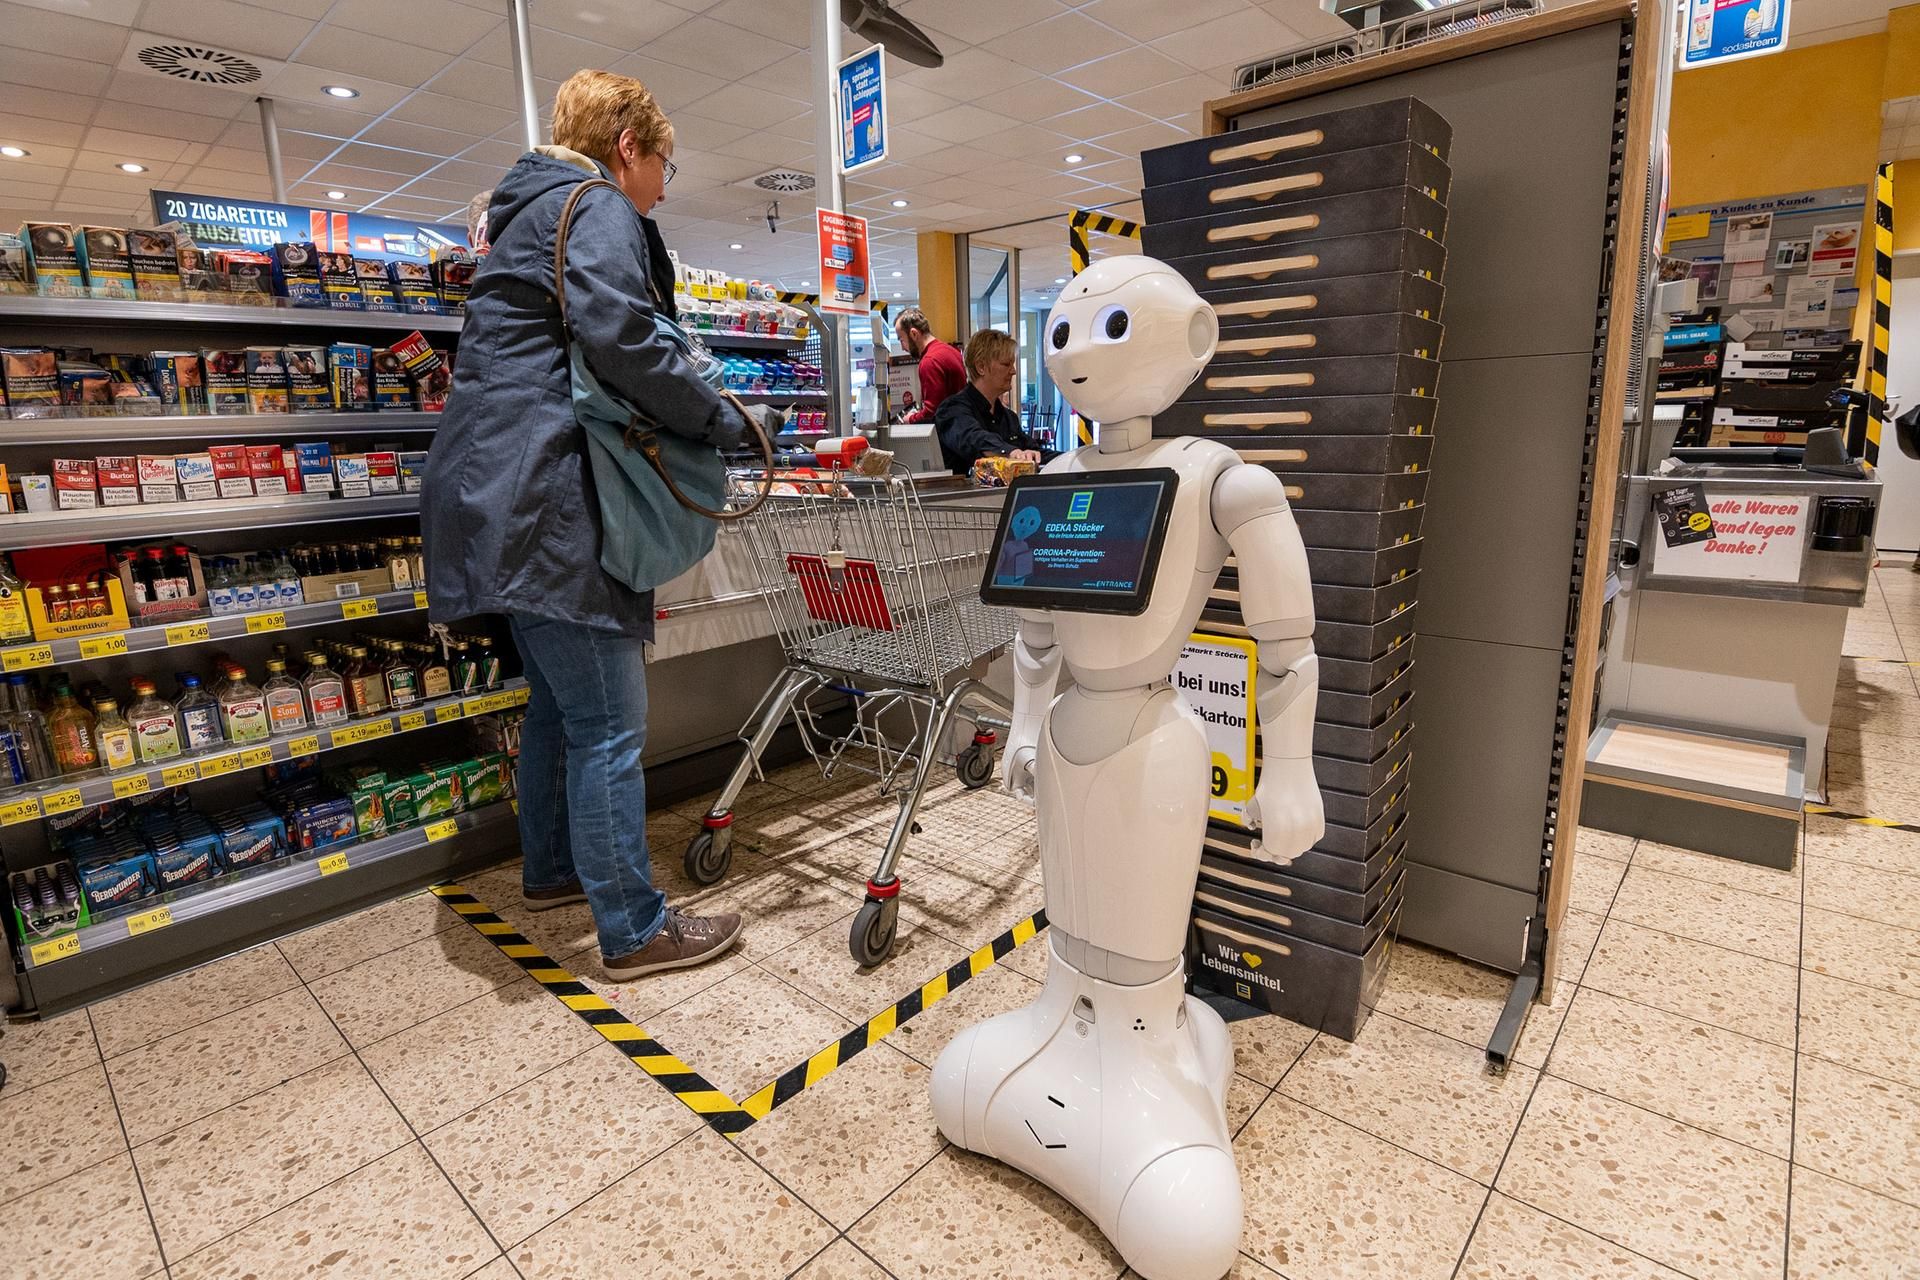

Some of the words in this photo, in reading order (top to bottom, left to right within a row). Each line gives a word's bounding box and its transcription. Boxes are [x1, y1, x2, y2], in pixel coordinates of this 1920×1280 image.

[1722, 37, 1777, 54] sodastream
[852, 66, 874, 82] sprudeln
[1721, 203, 1756, 214] Kunde
[1776, 196, 1816, 206] Kunde
[166, 200, 186, 218] 20
[190, 202, 288, 228] ZIGARETTEN
[822, 216, 862, 230] JUGENDSCHUTZ
[197, 222, 282, 246] AUSZEITEN
[141, 466, 174, 480] Chesterfield
[180, 463, 212, 480] Chesterfield
[1711, 500, 1742, 514] alle
[1744, 502, 1799, 516] Waren
[1045, 524, 1071, 532] EDEKA
[1073, 523, 1104, 532] Stöcker
[1748, 522, 1796, 540] legen
[1034, 548, 1106, 557] CORONA-Prävention:
[362, 603, 377, 612] 0,99
[267, 616, 285, 626] 0,99
[190, 627, 208, 638] 2,49
[106, 639, 126, 649] 1,00
[30, 650, 52, 662] 2,99
[1215, 650, 1248, 660] Stöcker
[1178, 670, 1202, 691] bei
[1208, 680, 1246, 698] uns!
[479, 700, 493, 709] 1,99
[501, 695, 514, 704] 2,69
[447, 707, 460, 716] 1,99
[410, 716, 425, 725] 2,29
[351, 728, 366, 738] 2,19
[377, 722, 392, 732] 2,69
[79, 726, 90, 749] APFEL
[302, 740, 318, 749] 1,99
[255, 750, 271, 760] 1,99
[222, 758, 240, 768] 2,39
[177, 768, 196, 778] 2,19
[467, 763, 500, 785] Underberg
[129, 778, 148, 790] 1,39
[416, 777, 451, 800] Underberg
[384, 784, 409, 800] Underberg
[60, 794, 81, 805] 2,29
[17, 804, 38, 815] 3,99
[443, 822, 457, 832] 3,49
[229, 834, 273, 863] BERGWUNDER
[162, 853, 209, 883] BERGWUNDER
[331, 856, 347, 868] 0,99
[91, 871, 141, 902] BERGWUNDER
[152, 910, 170, 922] 0,99
[58, 938, 79, 950] 0,49
[1218, 944, 1240, 962] Wir
[1202, 952, 1285, 993] Lebensmittel.
